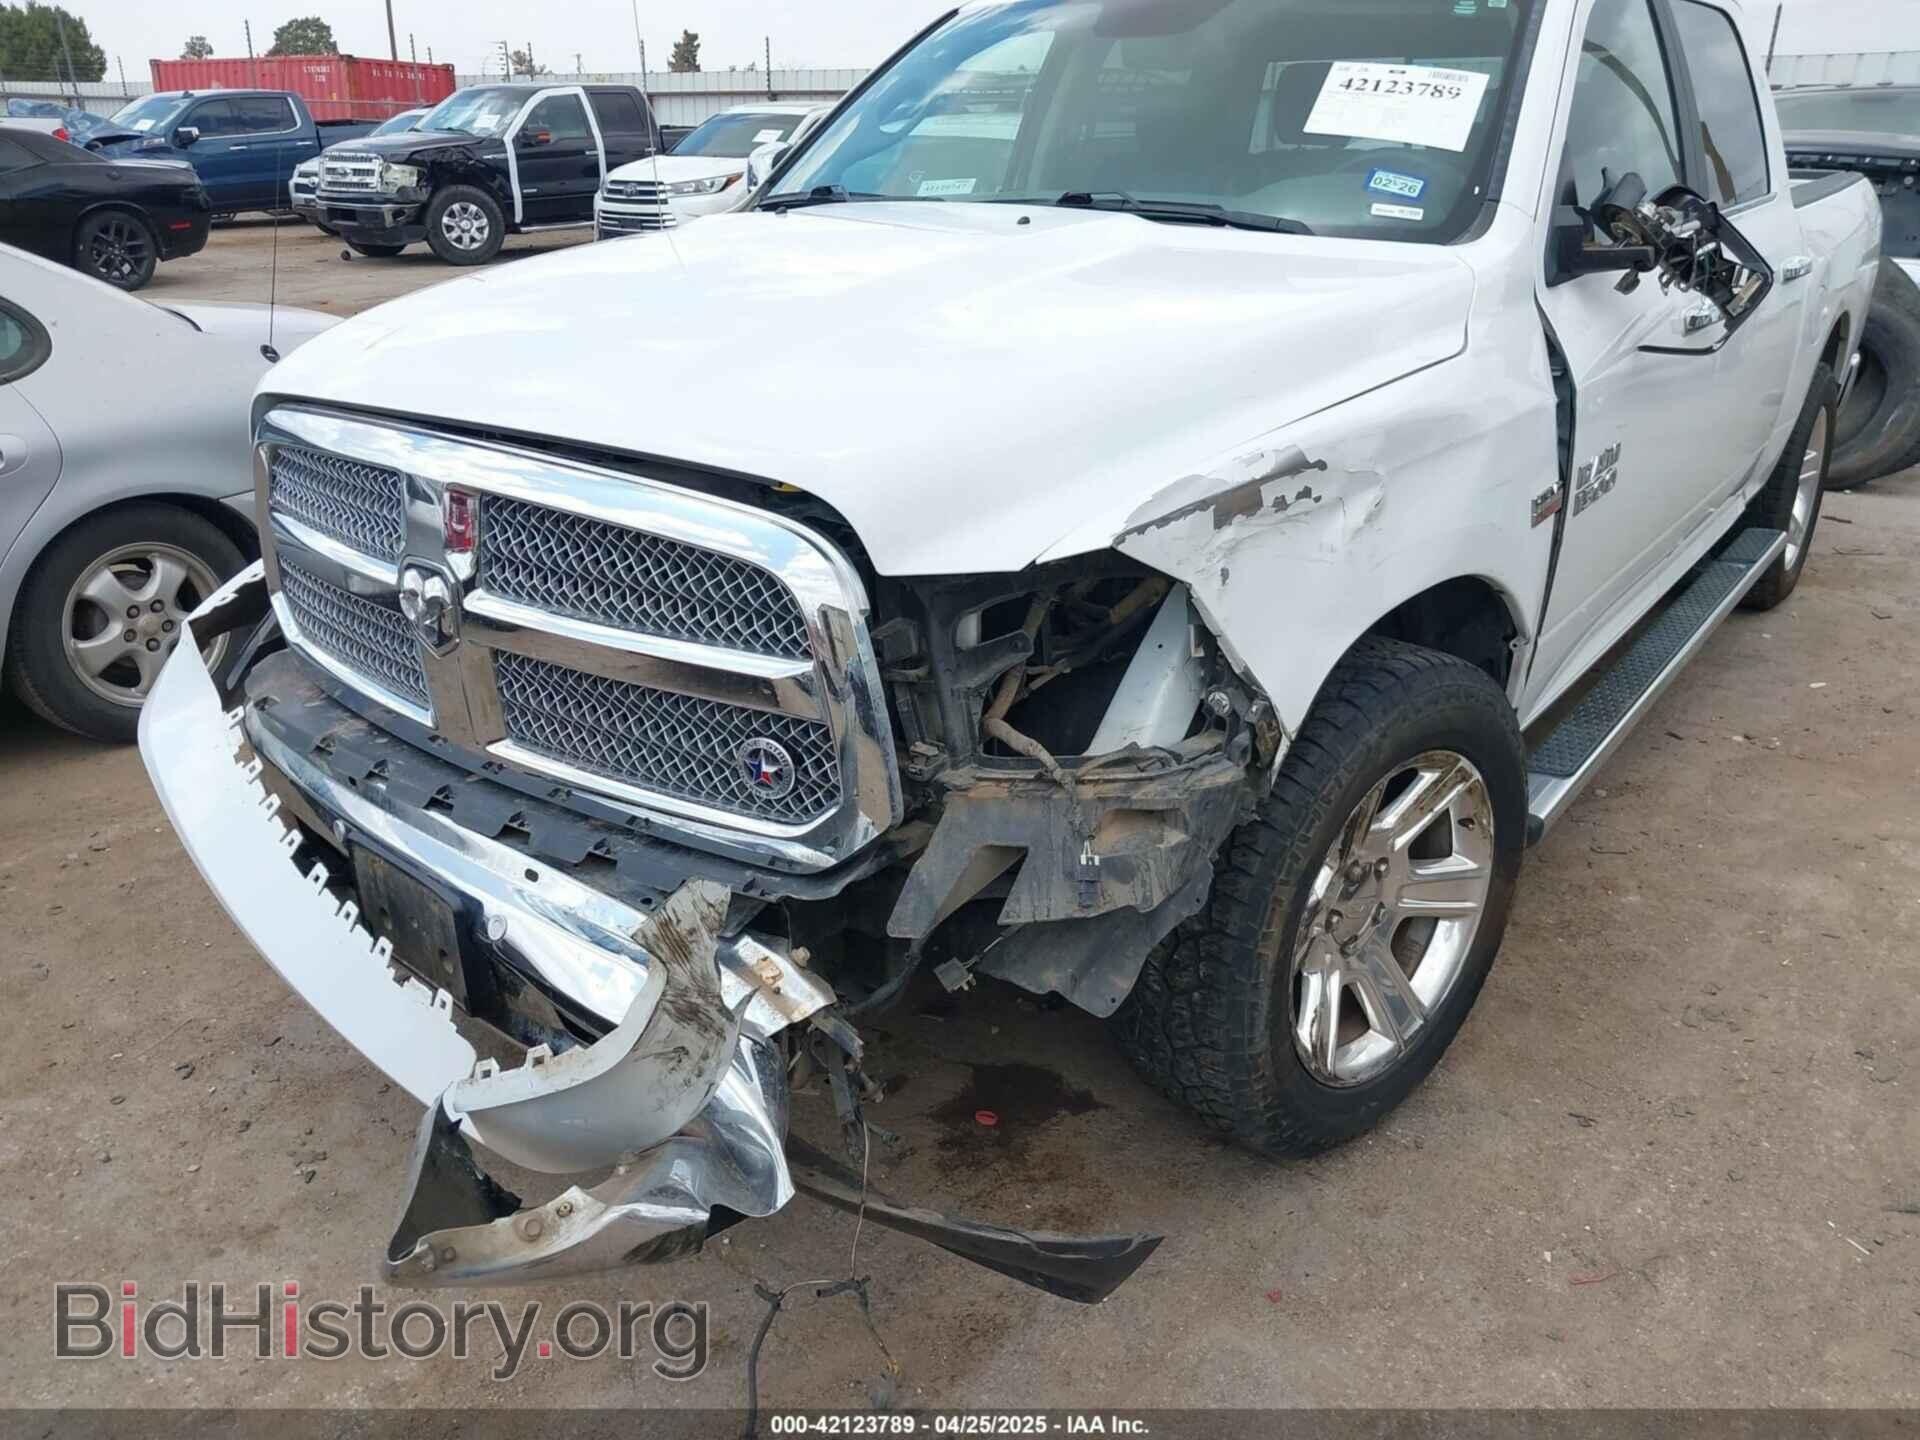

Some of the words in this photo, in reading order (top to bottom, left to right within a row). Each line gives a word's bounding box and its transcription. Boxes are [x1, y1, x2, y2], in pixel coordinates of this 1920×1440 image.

[1339, 76, 1462, 100] 42123789
[1373, 176, 1393, 188] 02
[1397, 182, 1418, 194] 26
